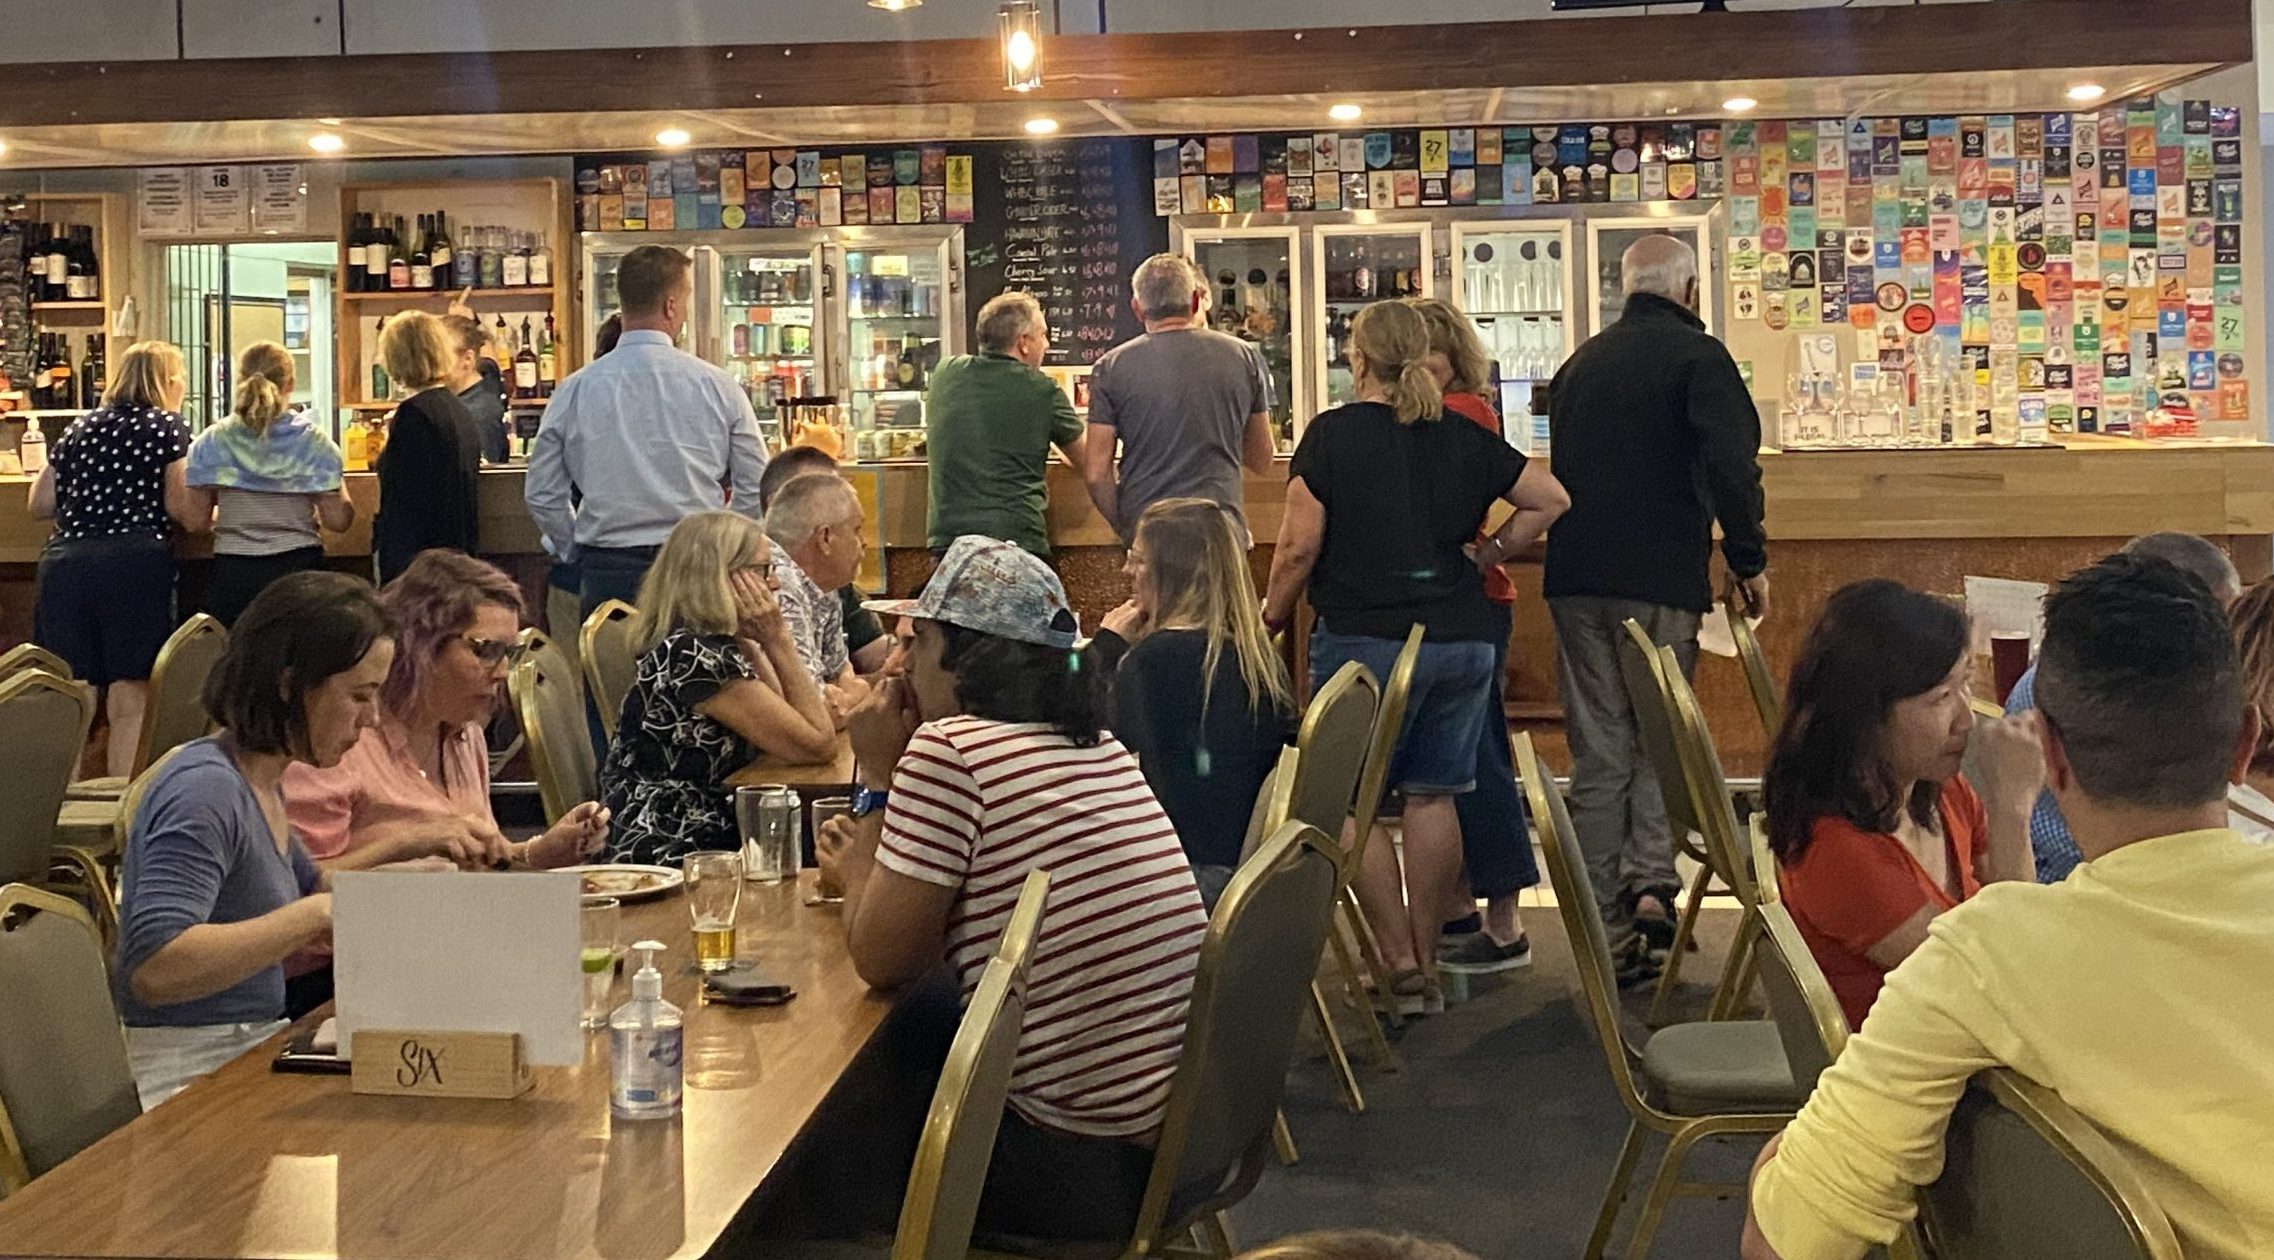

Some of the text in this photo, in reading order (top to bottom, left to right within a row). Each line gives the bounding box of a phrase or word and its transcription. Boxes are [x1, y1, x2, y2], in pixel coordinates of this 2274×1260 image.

[1425, 139, 1443, 162] 27
[212, 174, 230, 188] 18
[2221, 316, 2240, 341] 27
[397, 1039, 446, 1088] SIX
